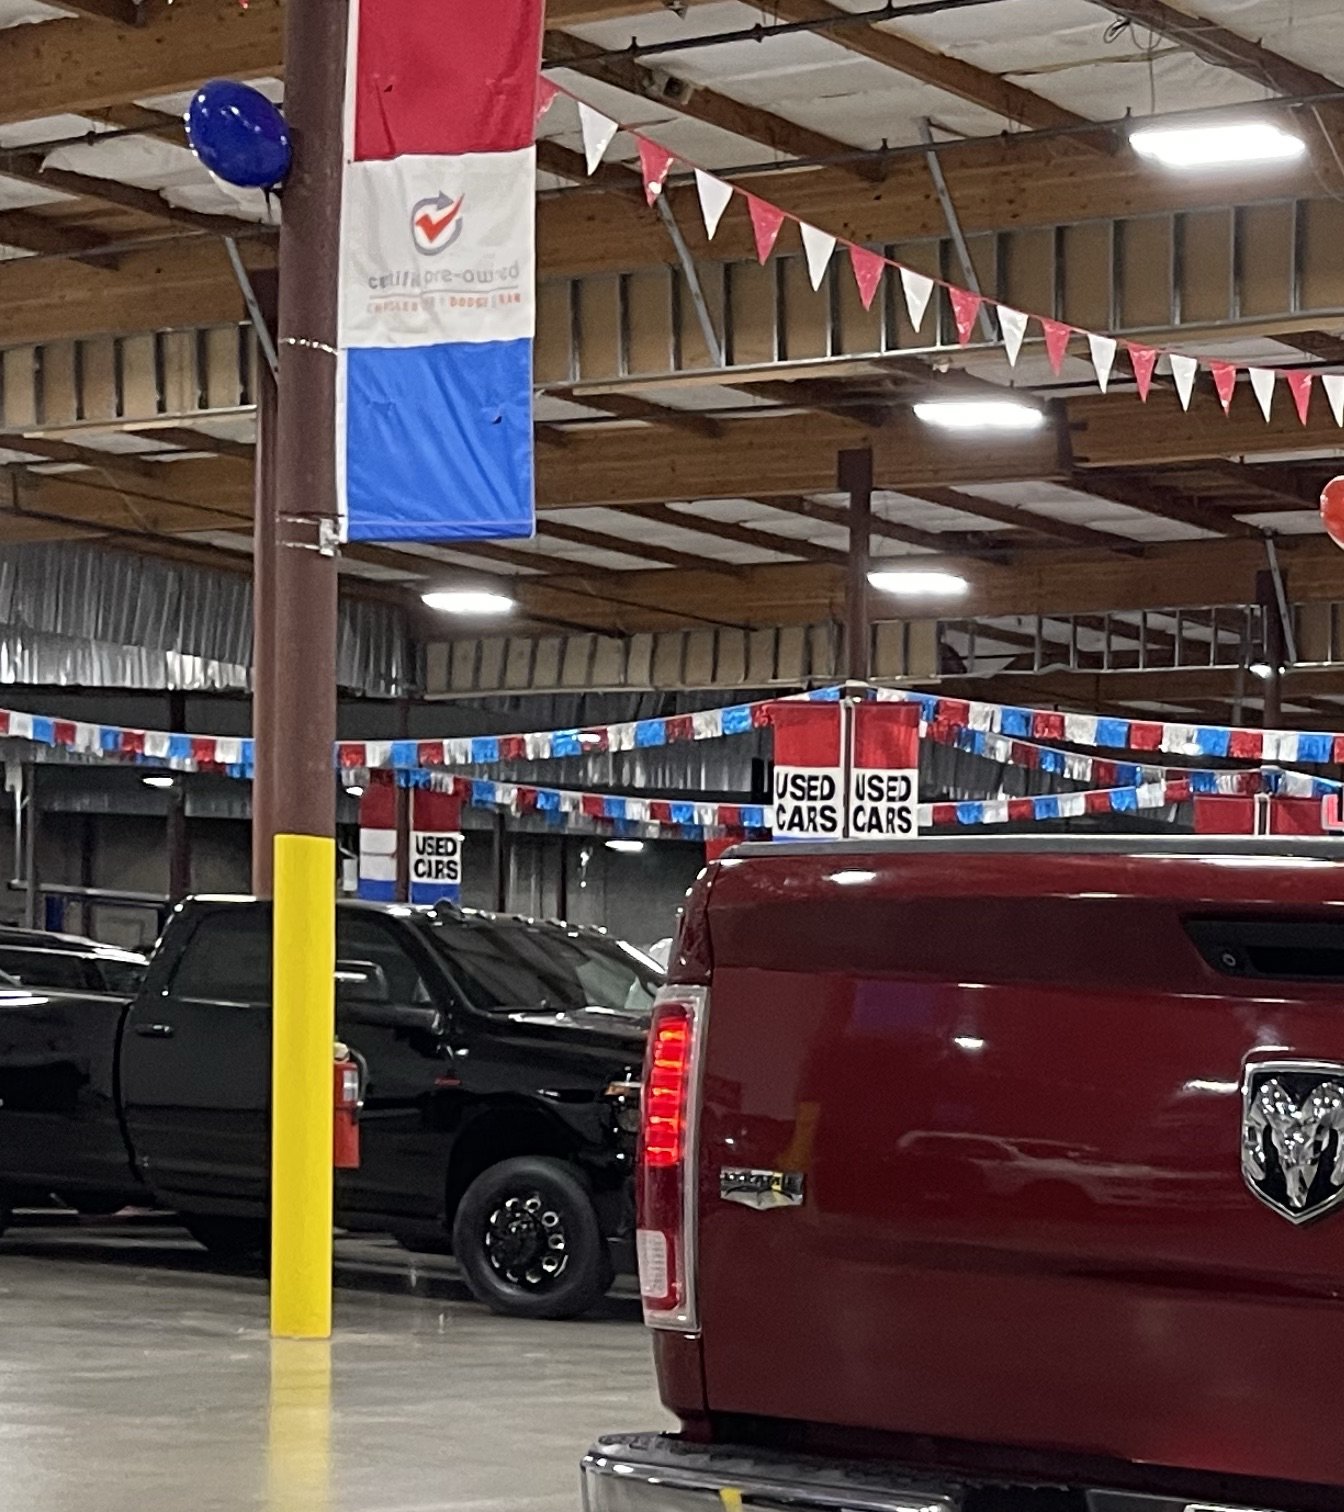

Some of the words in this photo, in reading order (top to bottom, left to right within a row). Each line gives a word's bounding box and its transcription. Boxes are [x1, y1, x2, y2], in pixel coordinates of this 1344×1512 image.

[776, 772, 836, 802] USED
[855, 773, 912, 803] USED
[776, 803, 838, 833] CARS
[853, 804, 913, 834] CARS
[415, 836, 458, 857] USED
